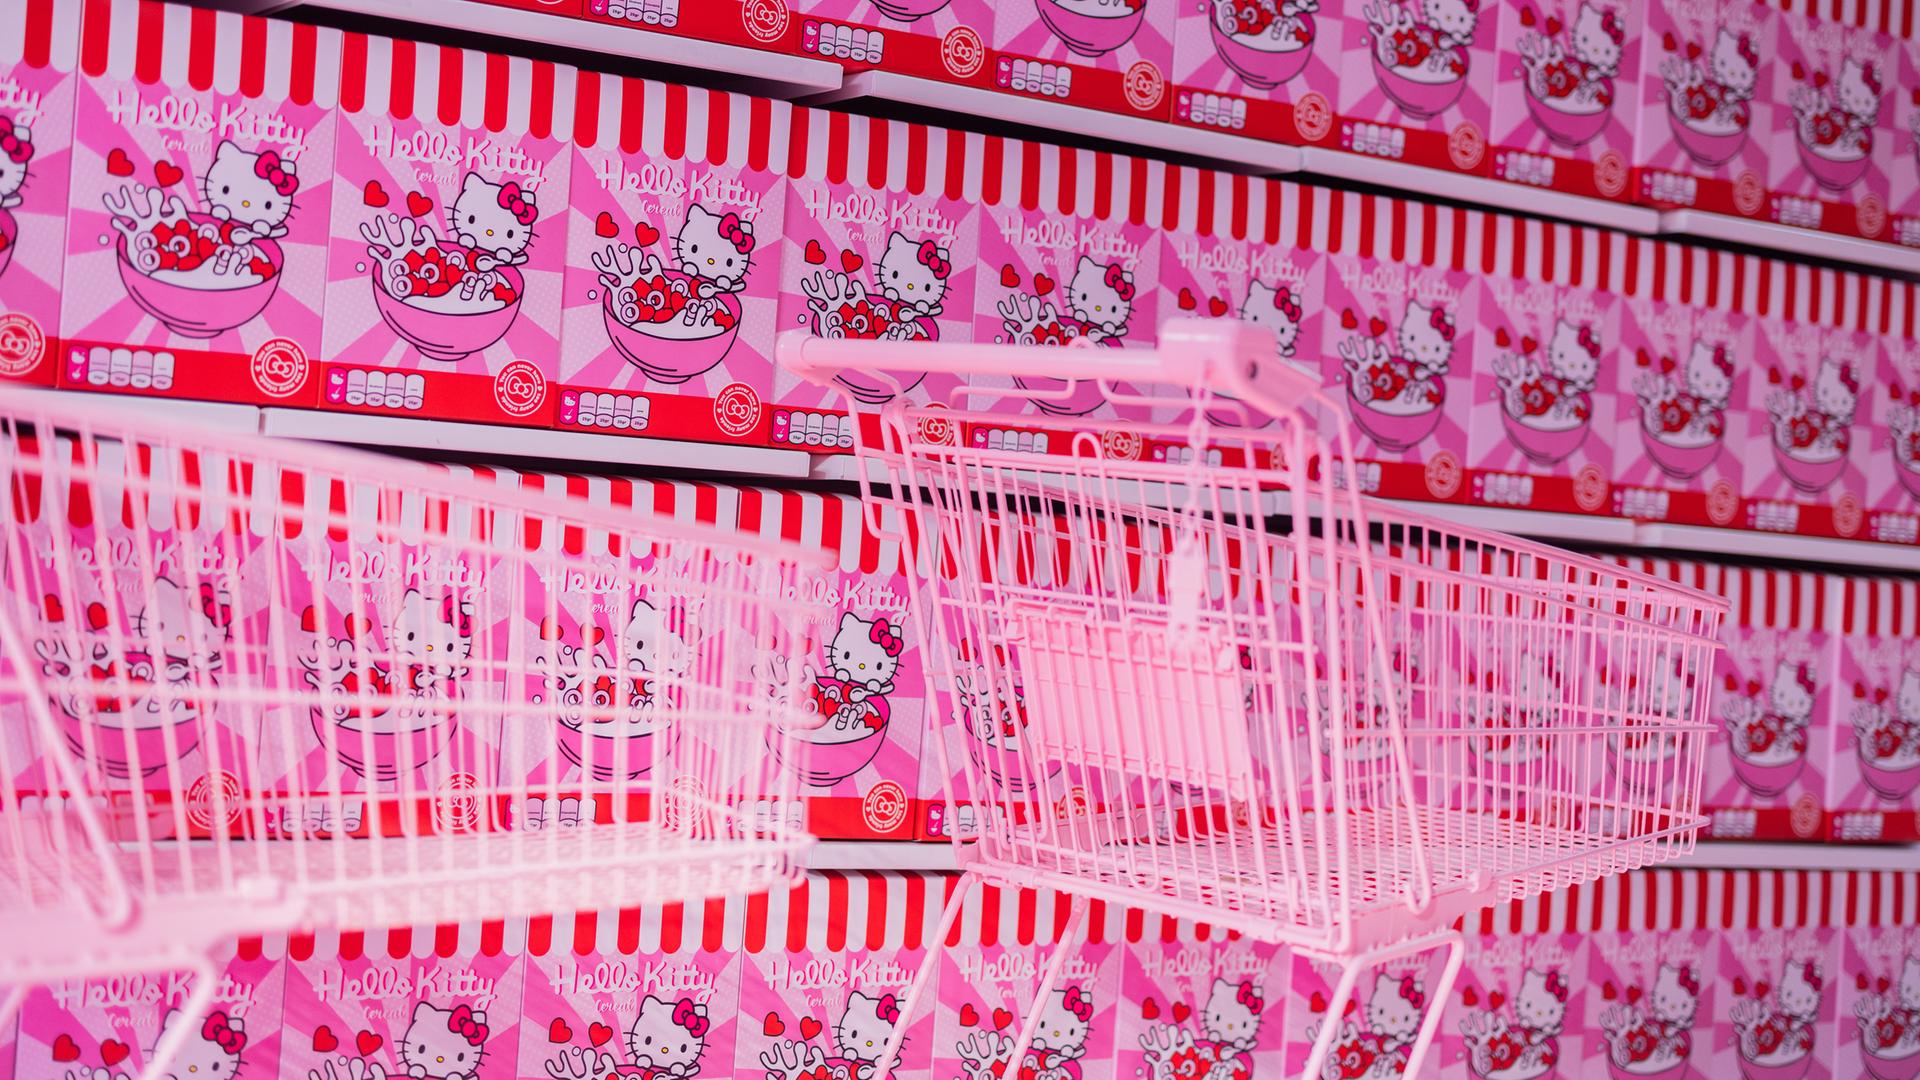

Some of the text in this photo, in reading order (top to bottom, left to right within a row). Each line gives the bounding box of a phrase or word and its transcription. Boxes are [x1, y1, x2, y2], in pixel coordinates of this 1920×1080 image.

[0, 77, 44, 129] tty
[107, 89, 308, 161] Hello Kitty
[363, 125, 547, 192] Hello Kitty
[596, 159, 763, 223] Hello Kitty
[804, 188, 959, 249] Hello Kitty
[1000, 215, 1141, 270] Hello Kitty
[1177, 240, 1249, 274] Hello
[1250, 246, 1306, 294] Kitty
[842, 579, 911, 627] Kitty
[53, 973, 164, 1010] Hello
[313, 966, 498, 1012] Hello Kitty
[549, 960, 718, 1005] Hello Kitty
[764, 958, 918, 1000] Hello Kitty
[959, 951, 1037, 984] Hello
